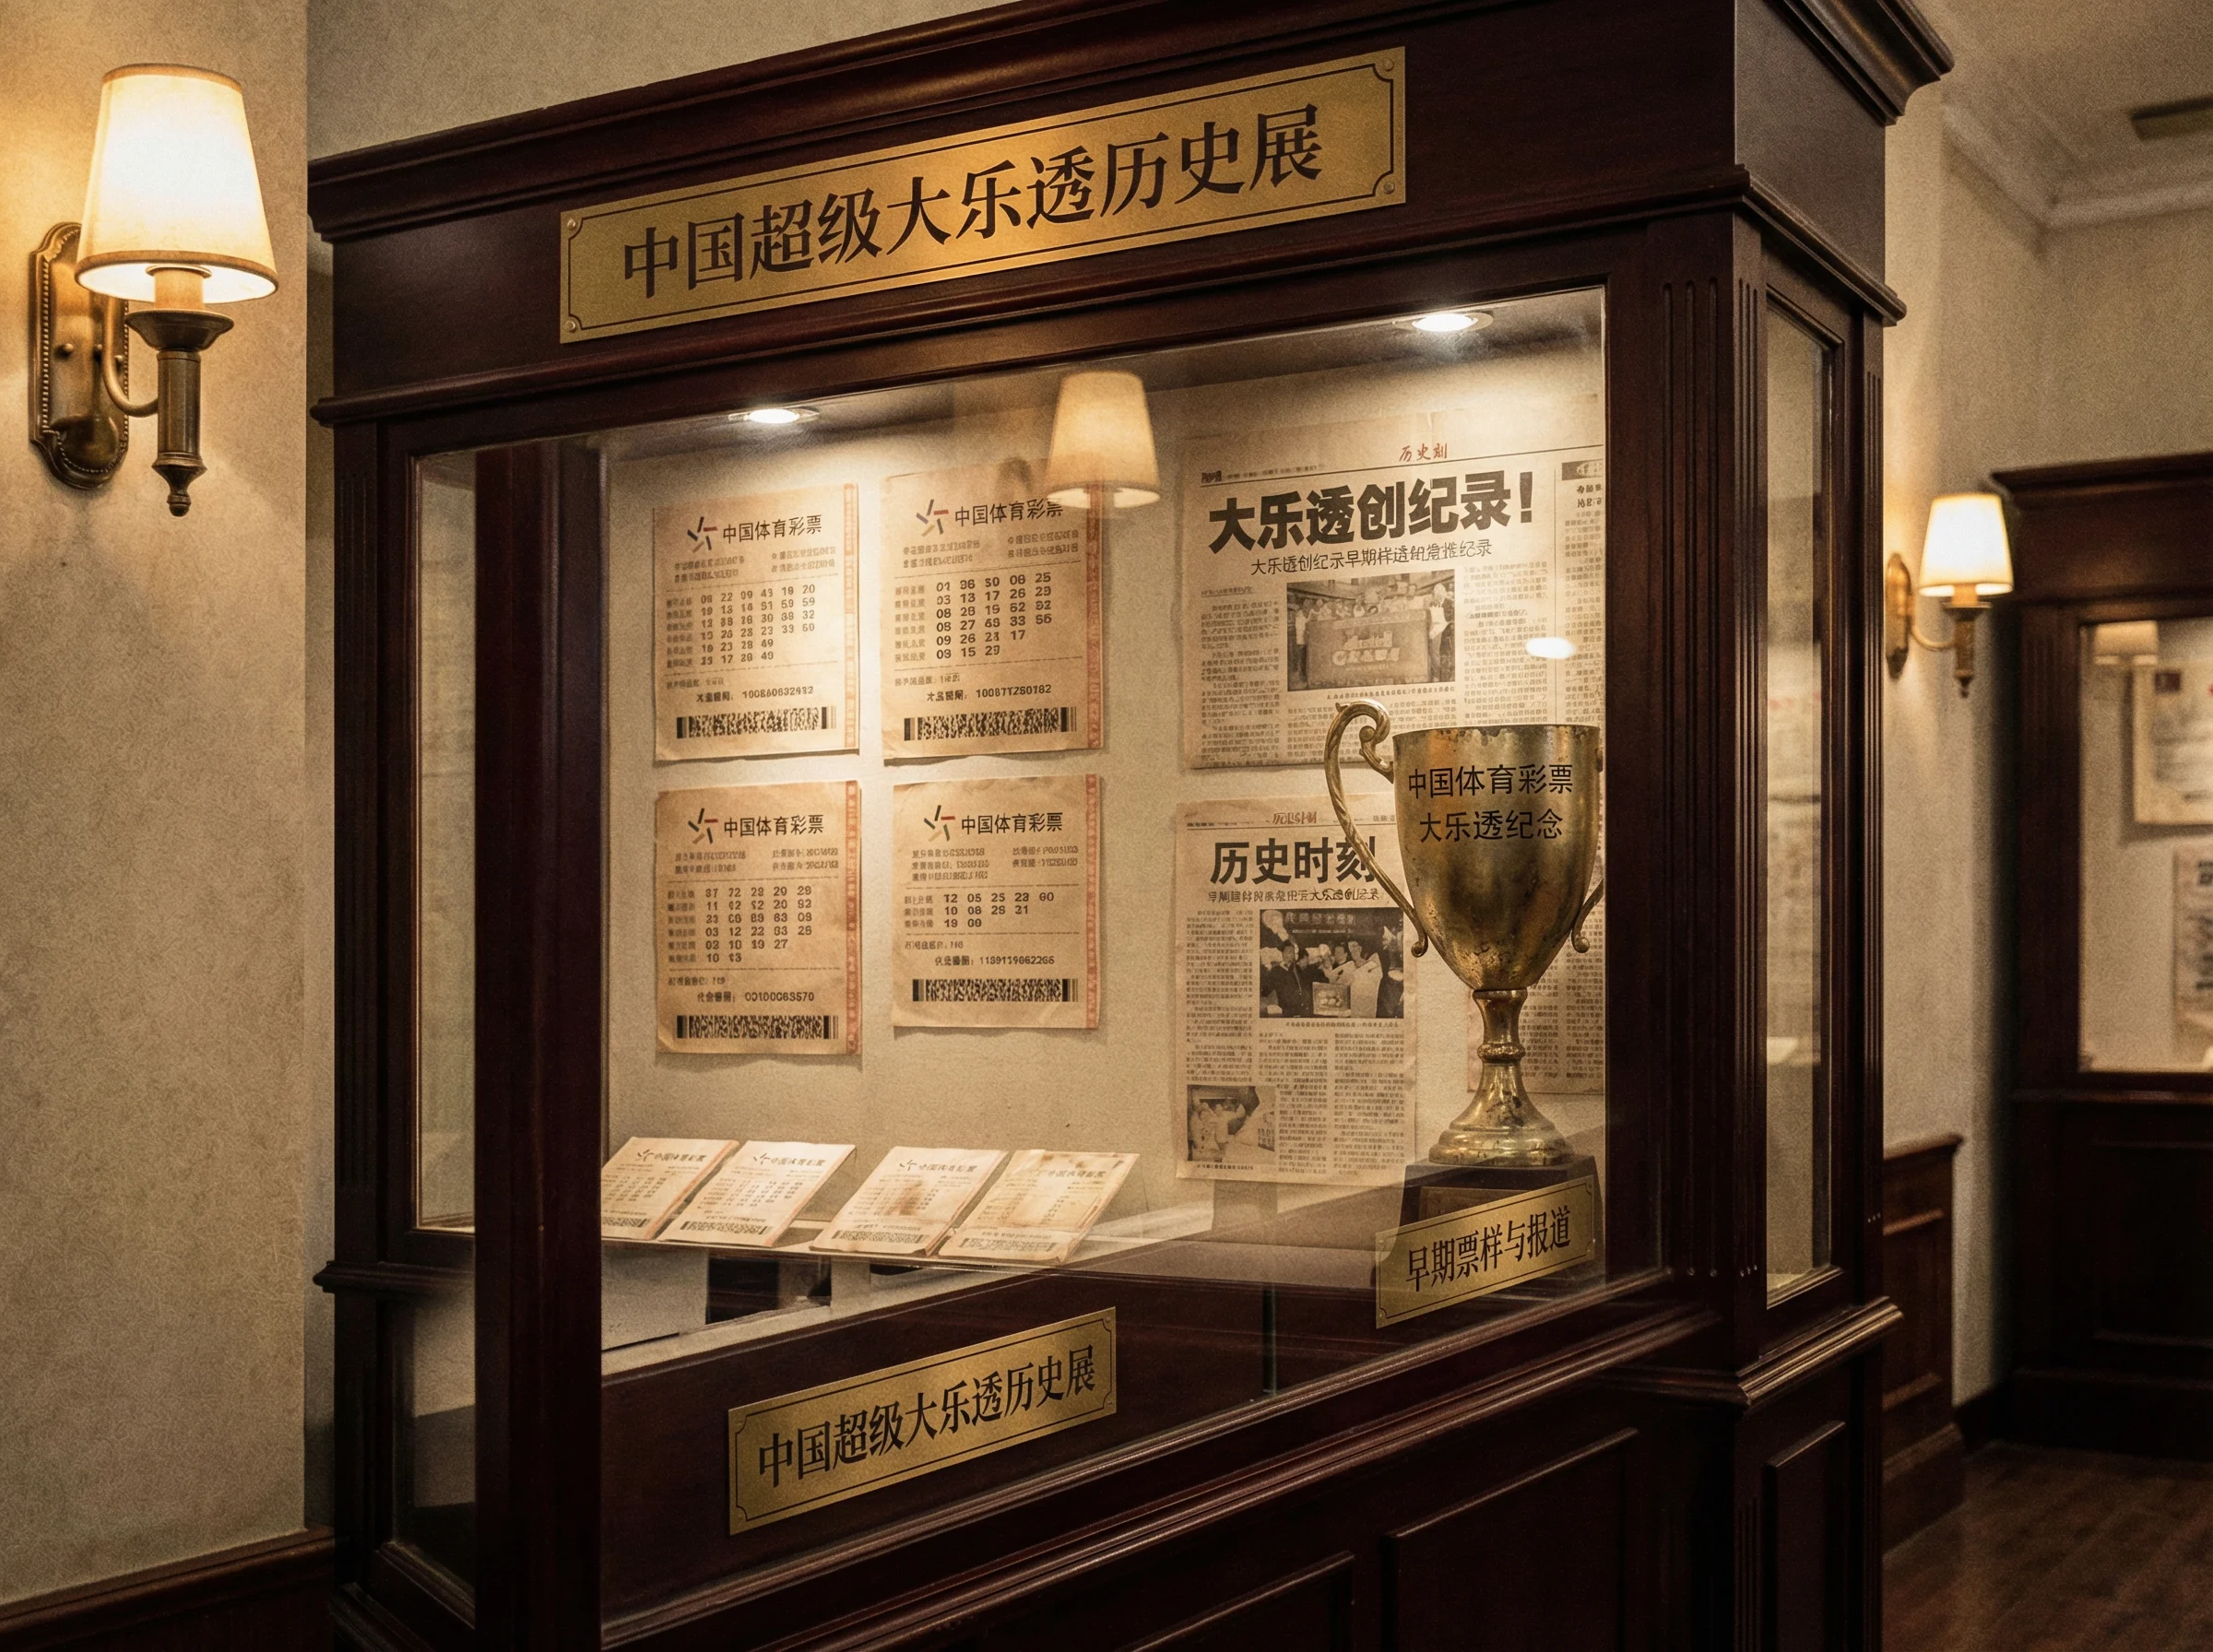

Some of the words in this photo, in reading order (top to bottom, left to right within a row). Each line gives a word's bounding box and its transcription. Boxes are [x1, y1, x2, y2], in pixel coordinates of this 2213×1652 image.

[624, 102, 1322, 299] 中国超级大乐透历史展
[954, 497, 1063, 526] 中国体育彩票
[723, 514, 822, 544] 中国体育彩票
[1035, 572, 1051, 584] 25
[985, 590, 1000, 601] 17
[936, 635, 952, 646] 09
[960, 633, 976, 644] 26
[1011, 630, 1025, 640] 17
[960, 620, 976, 631] 27
[961, 647, 976, 657] 15
[1408, 763, 1573, 799] 中国体育彩票
[724, 814, 824, 838] 中国体育彩票
[961, 812, 1063, 835] 中国体育彩票
[1419, 808, 1563, 843] 大乐透纪念
[1210, 836, 1376, 885] 历史时刻
[774, 938, 788, 950] 27
[1406, 1205, 1570, 1292] 早期票样与报道
[759, 1344, 1096, 1488] 中国超级大乐透历史展
